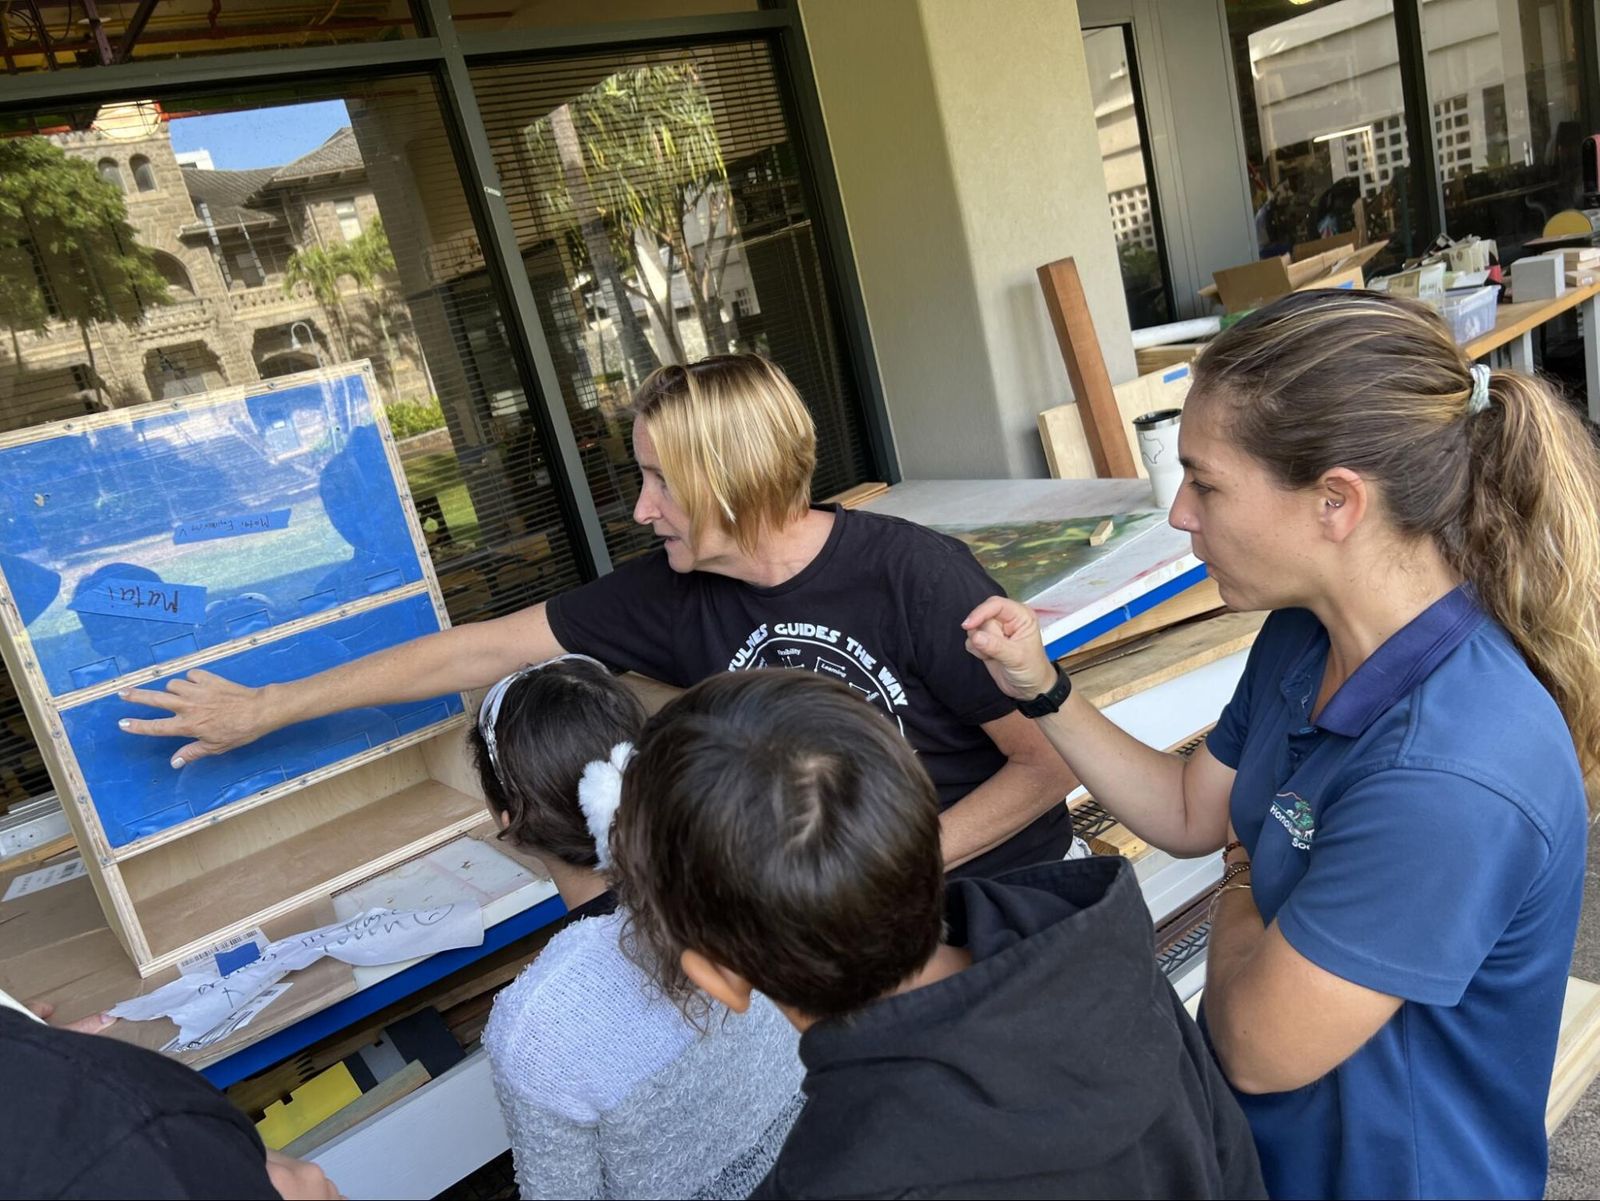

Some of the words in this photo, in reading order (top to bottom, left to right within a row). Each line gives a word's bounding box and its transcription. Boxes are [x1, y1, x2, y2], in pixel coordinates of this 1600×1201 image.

[107, 585, 179, 614] Matai
[773, 622, 842, 644] GUIDES
[845, 636, 878, 671] THE
[877, 665, 909, 706] WAY
